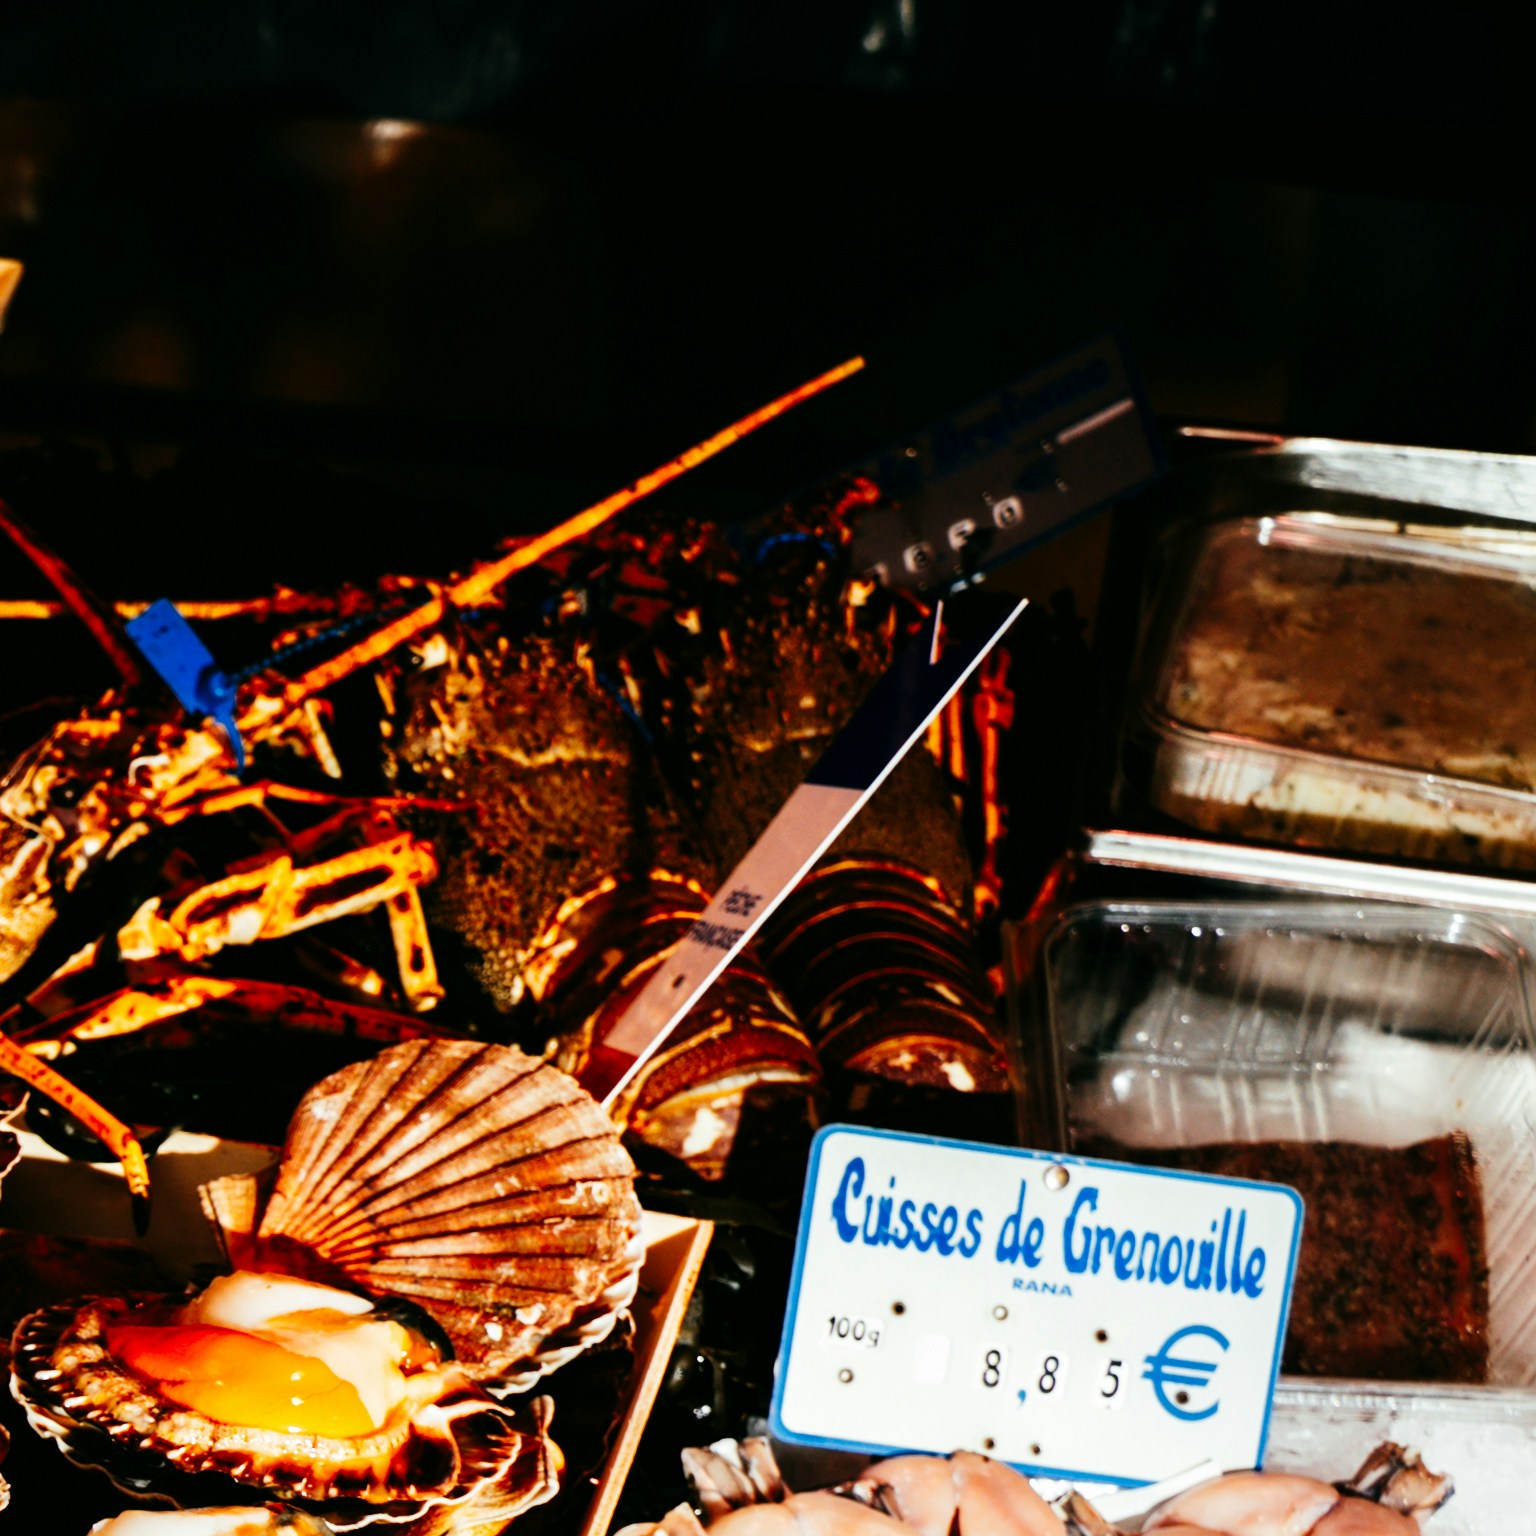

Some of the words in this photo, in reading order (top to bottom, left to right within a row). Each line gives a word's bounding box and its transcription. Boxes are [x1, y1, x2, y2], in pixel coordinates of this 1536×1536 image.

[831, 1155, 983, 1258] Cuisses
[996, 1177, 1044, 1269] de
[1063, 1186, 1267, 1300] Grenouille
[1011, 1277, 1074, 1298] RANA
[827, 1315, 881, 1348] 100g
